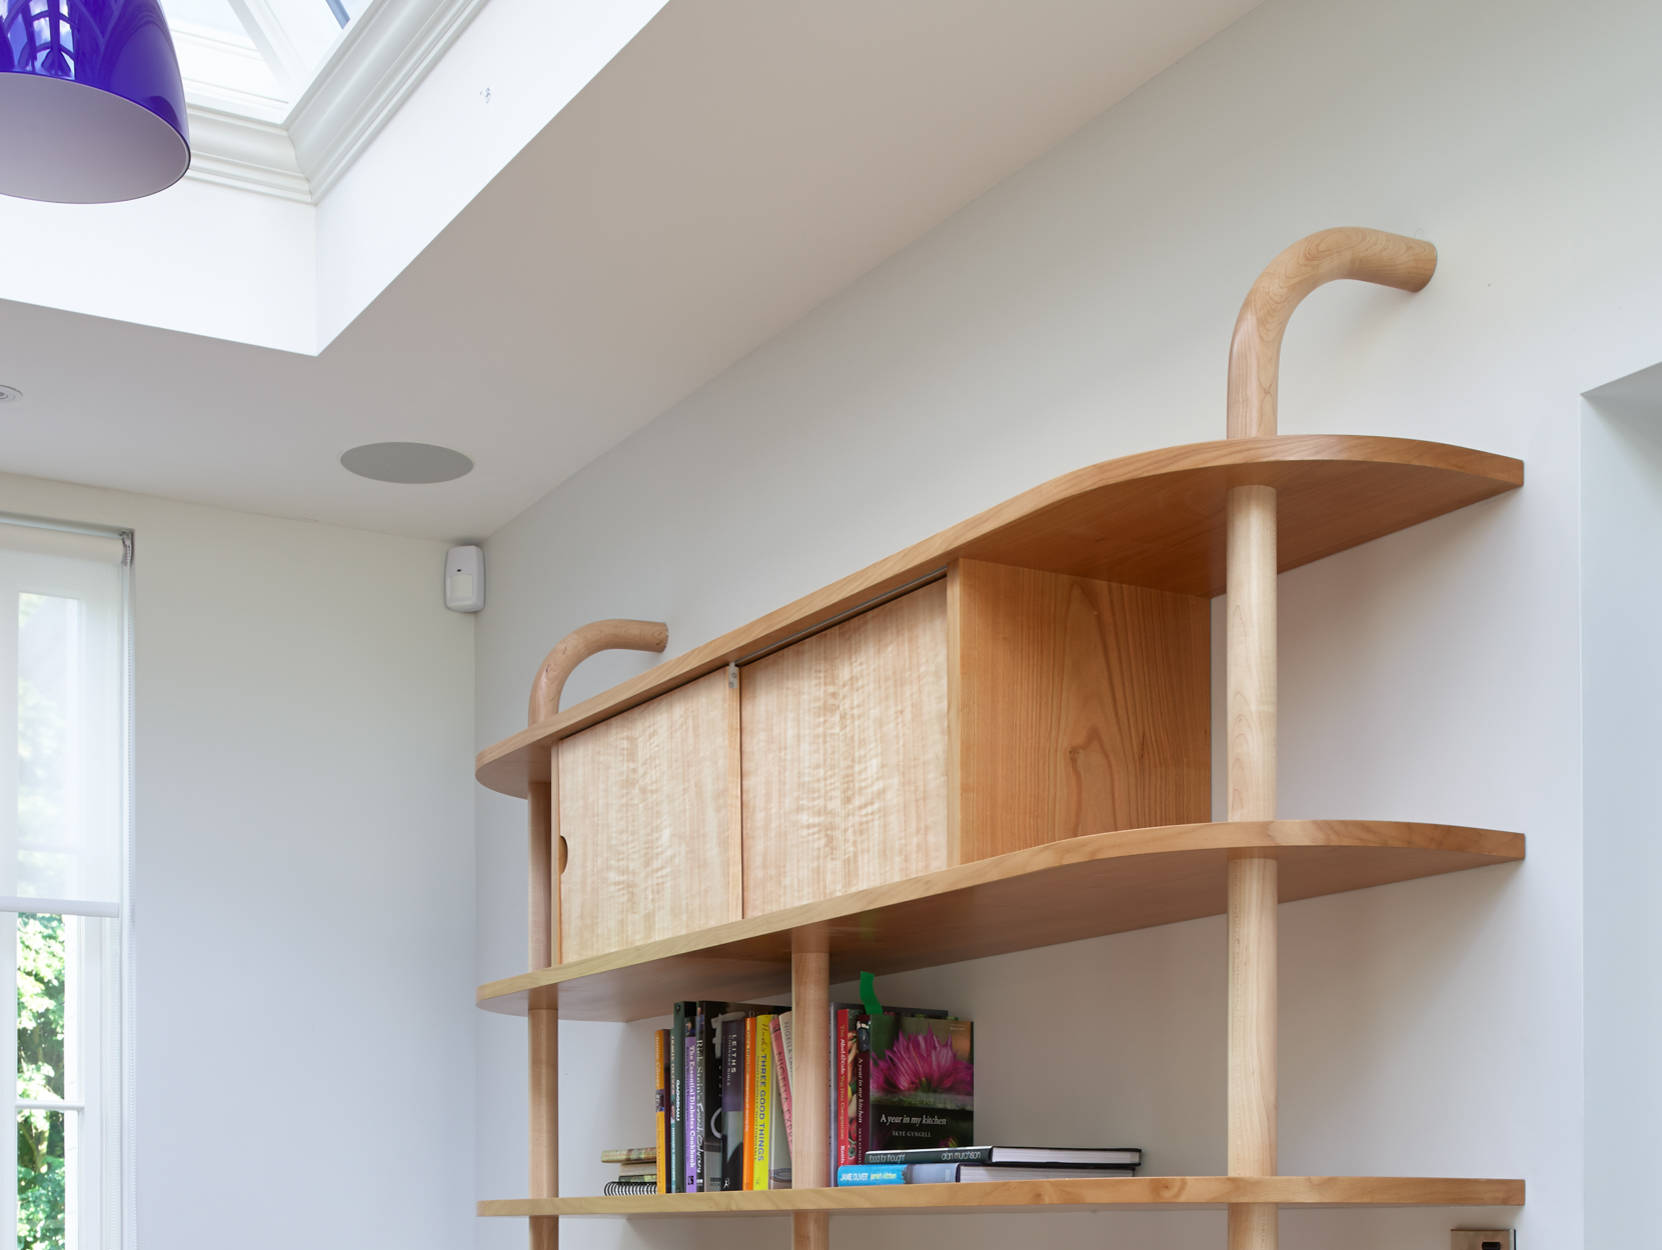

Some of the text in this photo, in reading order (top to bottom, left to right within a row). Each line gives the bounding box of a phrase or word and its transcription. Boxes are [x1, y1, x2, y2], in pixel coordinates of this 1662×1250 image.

[880, 1114, 947, 1127] A year in my kitchen
[757, 1123, 765, 1161] THINGS
[941, 1152, 954, 1161] alan
